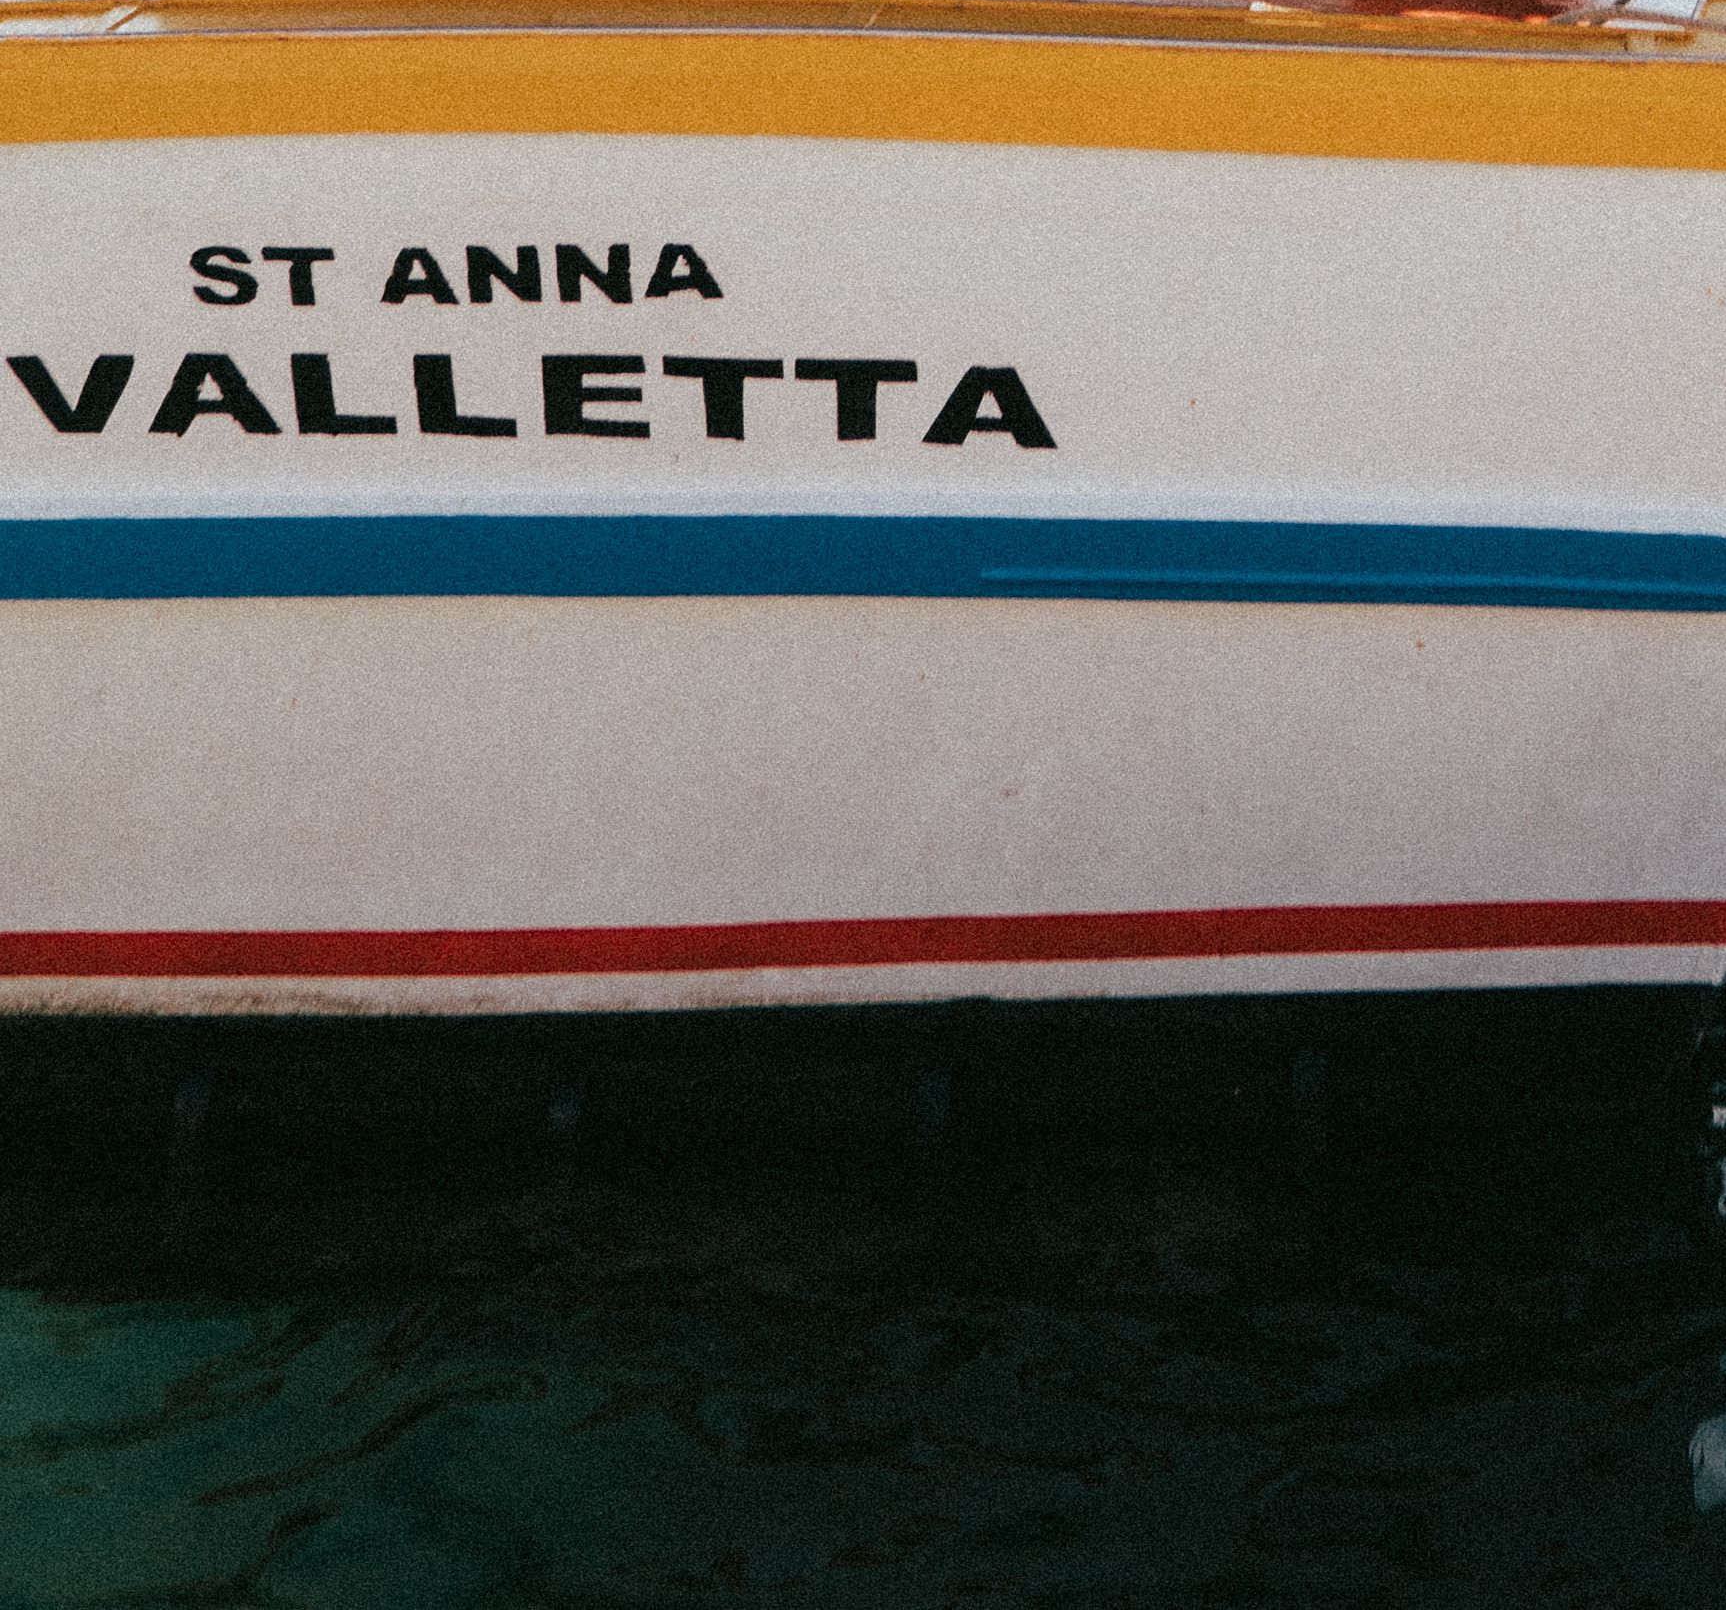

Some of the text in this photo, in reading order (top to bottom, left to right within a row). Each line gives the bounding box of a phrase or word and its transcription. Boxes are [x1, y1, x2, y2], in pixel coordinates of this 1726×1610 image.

[189, 243, 724, 307] ST ANNA
[6, 352, 1058, 450] VALLETTA
